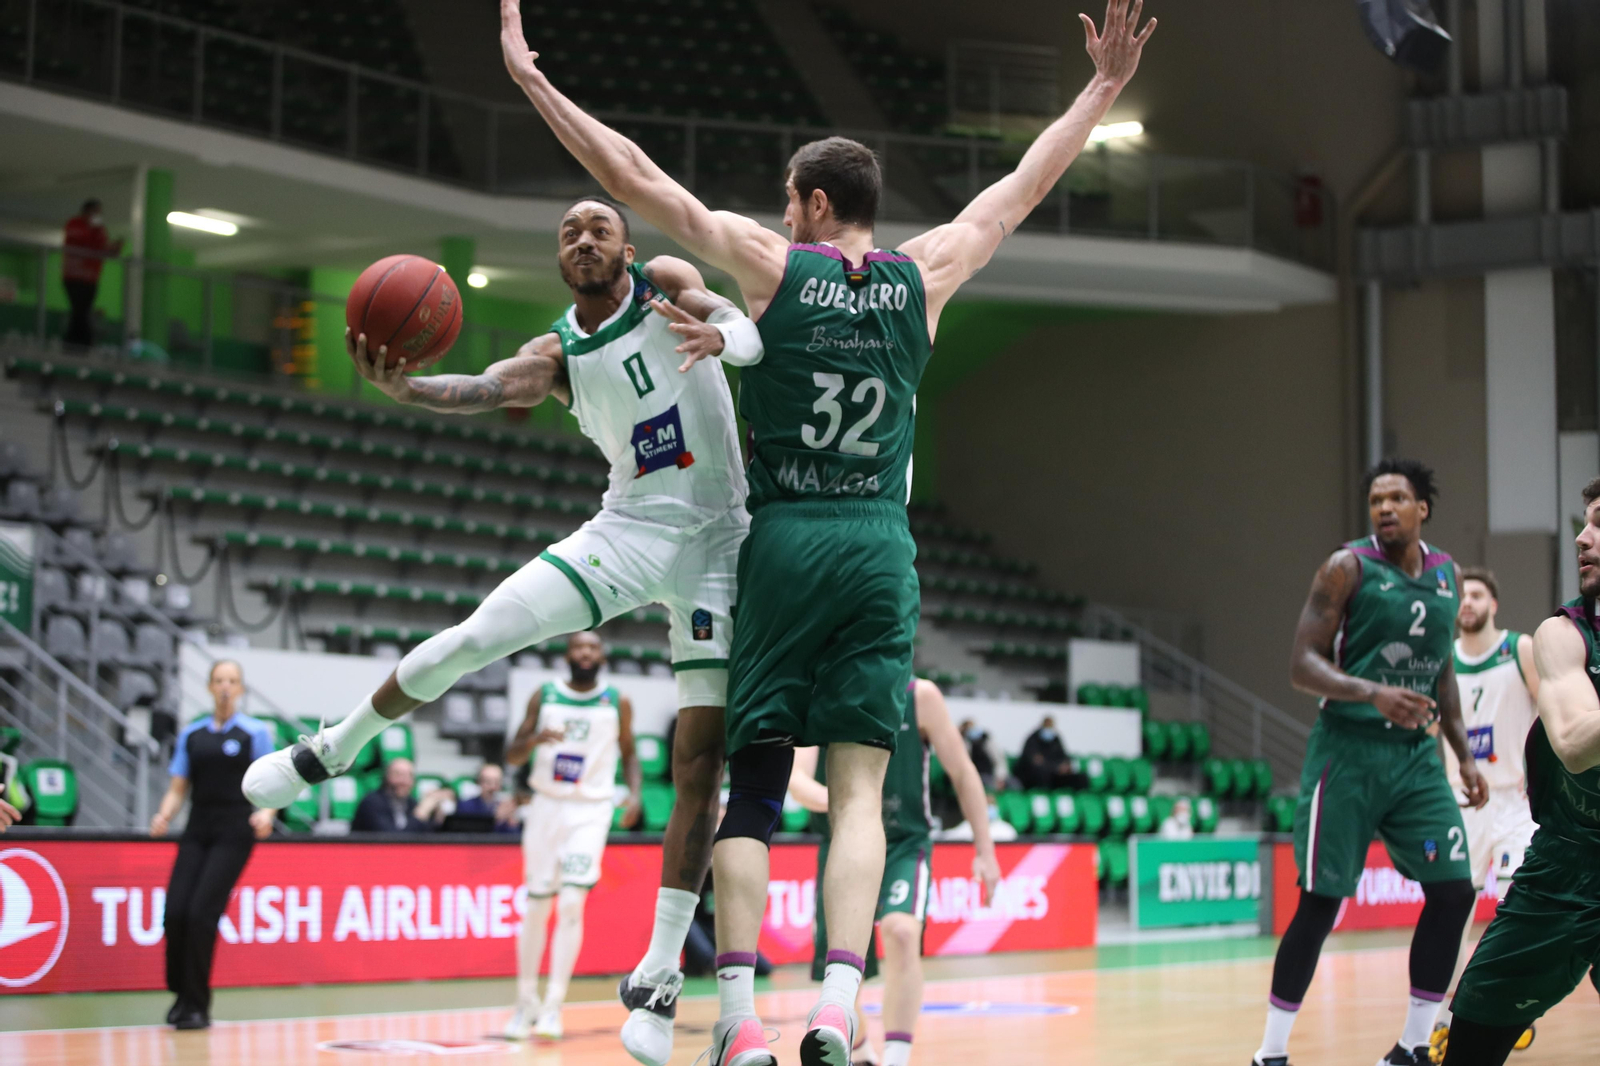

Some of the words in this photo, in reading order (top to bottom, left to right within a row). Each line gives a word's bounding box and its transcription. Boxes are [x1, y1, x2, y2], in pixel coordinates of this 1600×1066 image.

[800, 277, 908, 314] GUERRERO
[622, 351, 656, 399] 0
[801, 371, 886, 457] 32
[638, 423, 676, 456] GM
[645, 441, 678, 460] ATIMENT
[1408, 600, 1427, 636] 2
[1472, 687, 1483, 712] 7
[1448, 826, 1467, 861] 2
[889, 879, 910, 905] 9
[926, 876, 1049, 922] AIRLNES
[93, 885, 322, 946] TUISH
